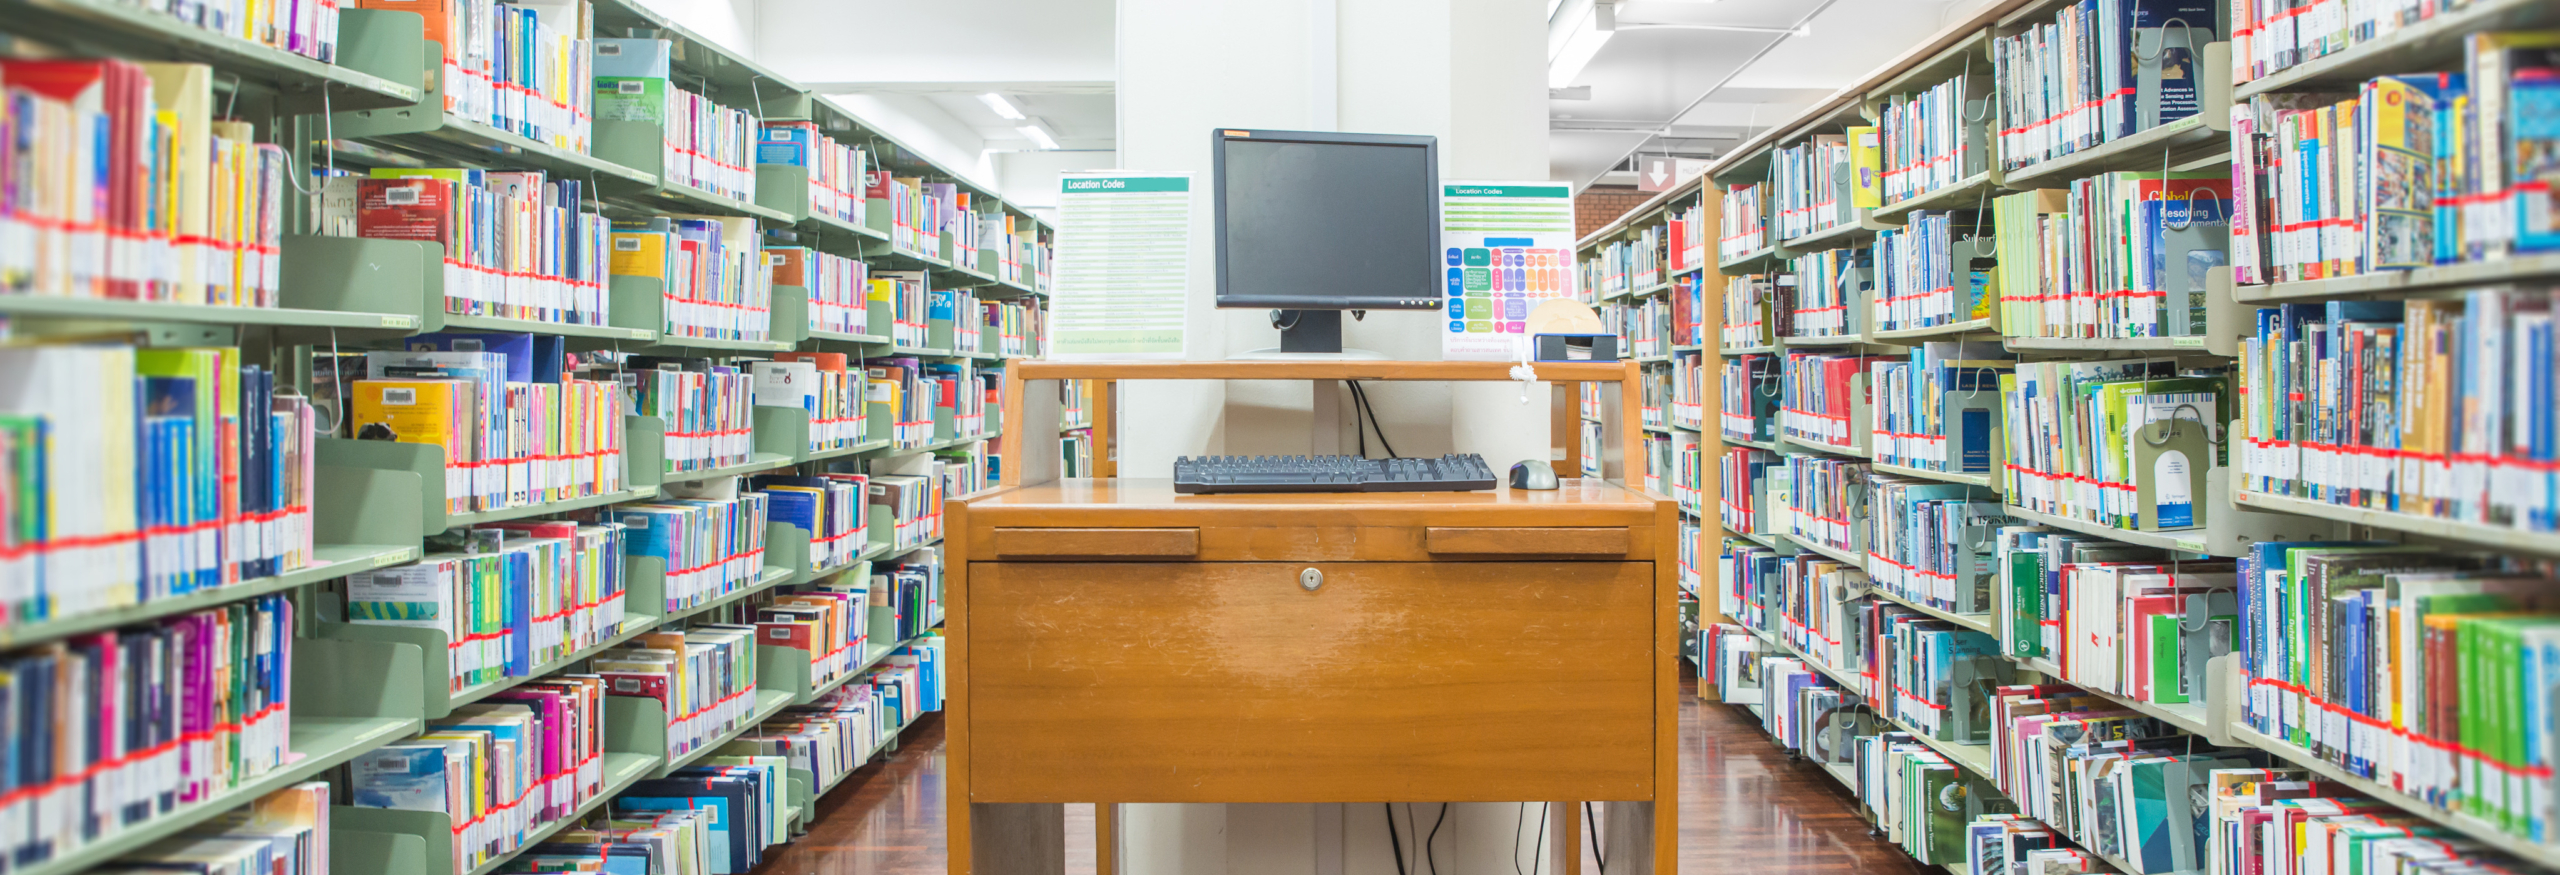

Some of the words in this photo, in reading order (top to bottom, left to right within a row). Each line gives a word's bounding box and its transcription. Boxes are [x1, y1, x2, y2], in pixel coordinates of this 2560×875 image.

[1068, 180, 1101, 189] Location
[1102, 179, 1125, 189] Codes
[2148, 190, 2189, 201] Global
[1962, 233, 1997, 242] Susurf
[1977, 515, 2019, 525] TSUNAMI
[2321, 601, 2329, 642] Program
[2322, 643, 2330, 704] Administratio
